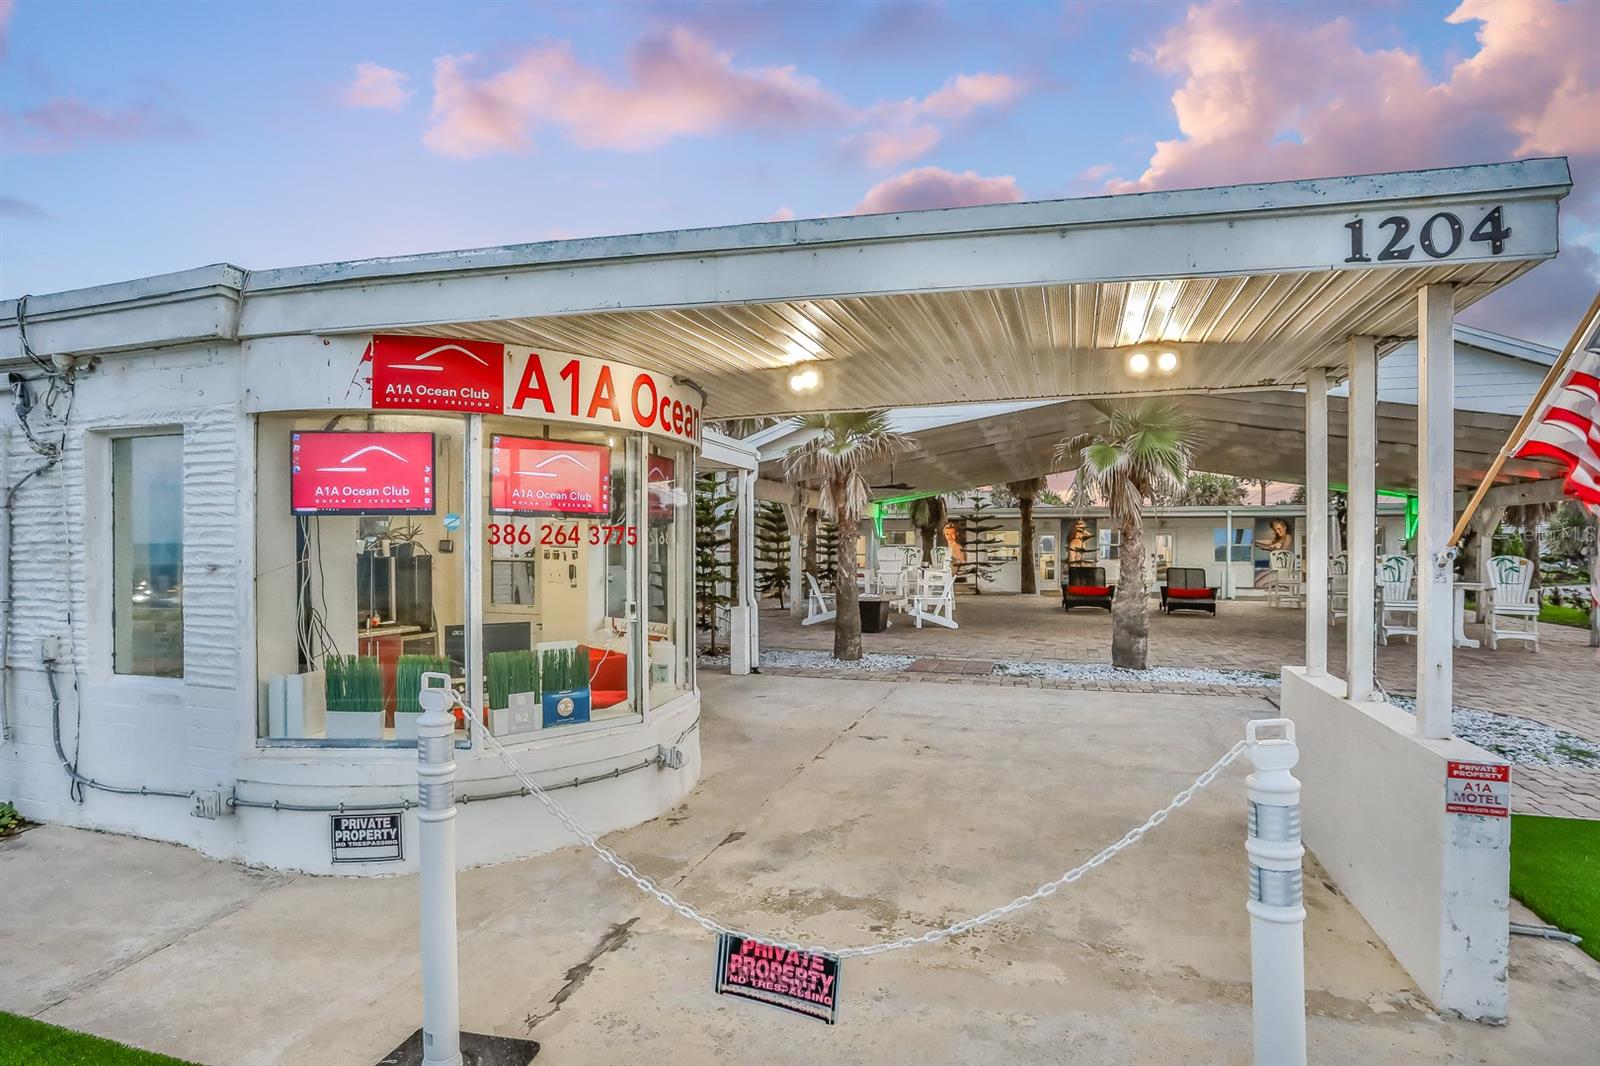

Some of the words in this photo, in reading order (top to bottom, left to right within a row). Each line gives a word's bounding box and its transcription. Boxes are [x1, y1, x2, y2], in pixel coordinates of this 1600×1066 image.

[1344, 205, 1512, 262] 1204
[385, 384, 413, 395] A1A
[416, 385, 457, 397] Ocean
[460, 387, 490, 400] Club
[511, 353, 621, 422] A1A
[631, 373, 700, 441] Ocean
[315, 486, 339, 496] A1A
[342, 486, 379, 496] Ocean
[382, 486, 410, 496] Club
[512, 488, 533, 498] A1A
[536, 490, 567, 500] Ocean
[569, 491, 592, 501] Club
[487, 524, 531, 545] 386
[540, 524, 580, 545] 264
[588, 525, 638, 546] 3775
[1453, 770, 1503, 779] PROPERTY
[1458, 764, 1497, 773] PRIVATE
[1464, 782, 1492, 793] A1A
[1454, 792, 1502, 805] MOTEL
[341, 817, 391, 830] PRIVATE
[335, 828, 397, 841] PROPERTY
[742, 939, 825, 971] PRIVATE
[729, 953, 834, 994] PROPERTY
[729, 975, 746, 984] NO
